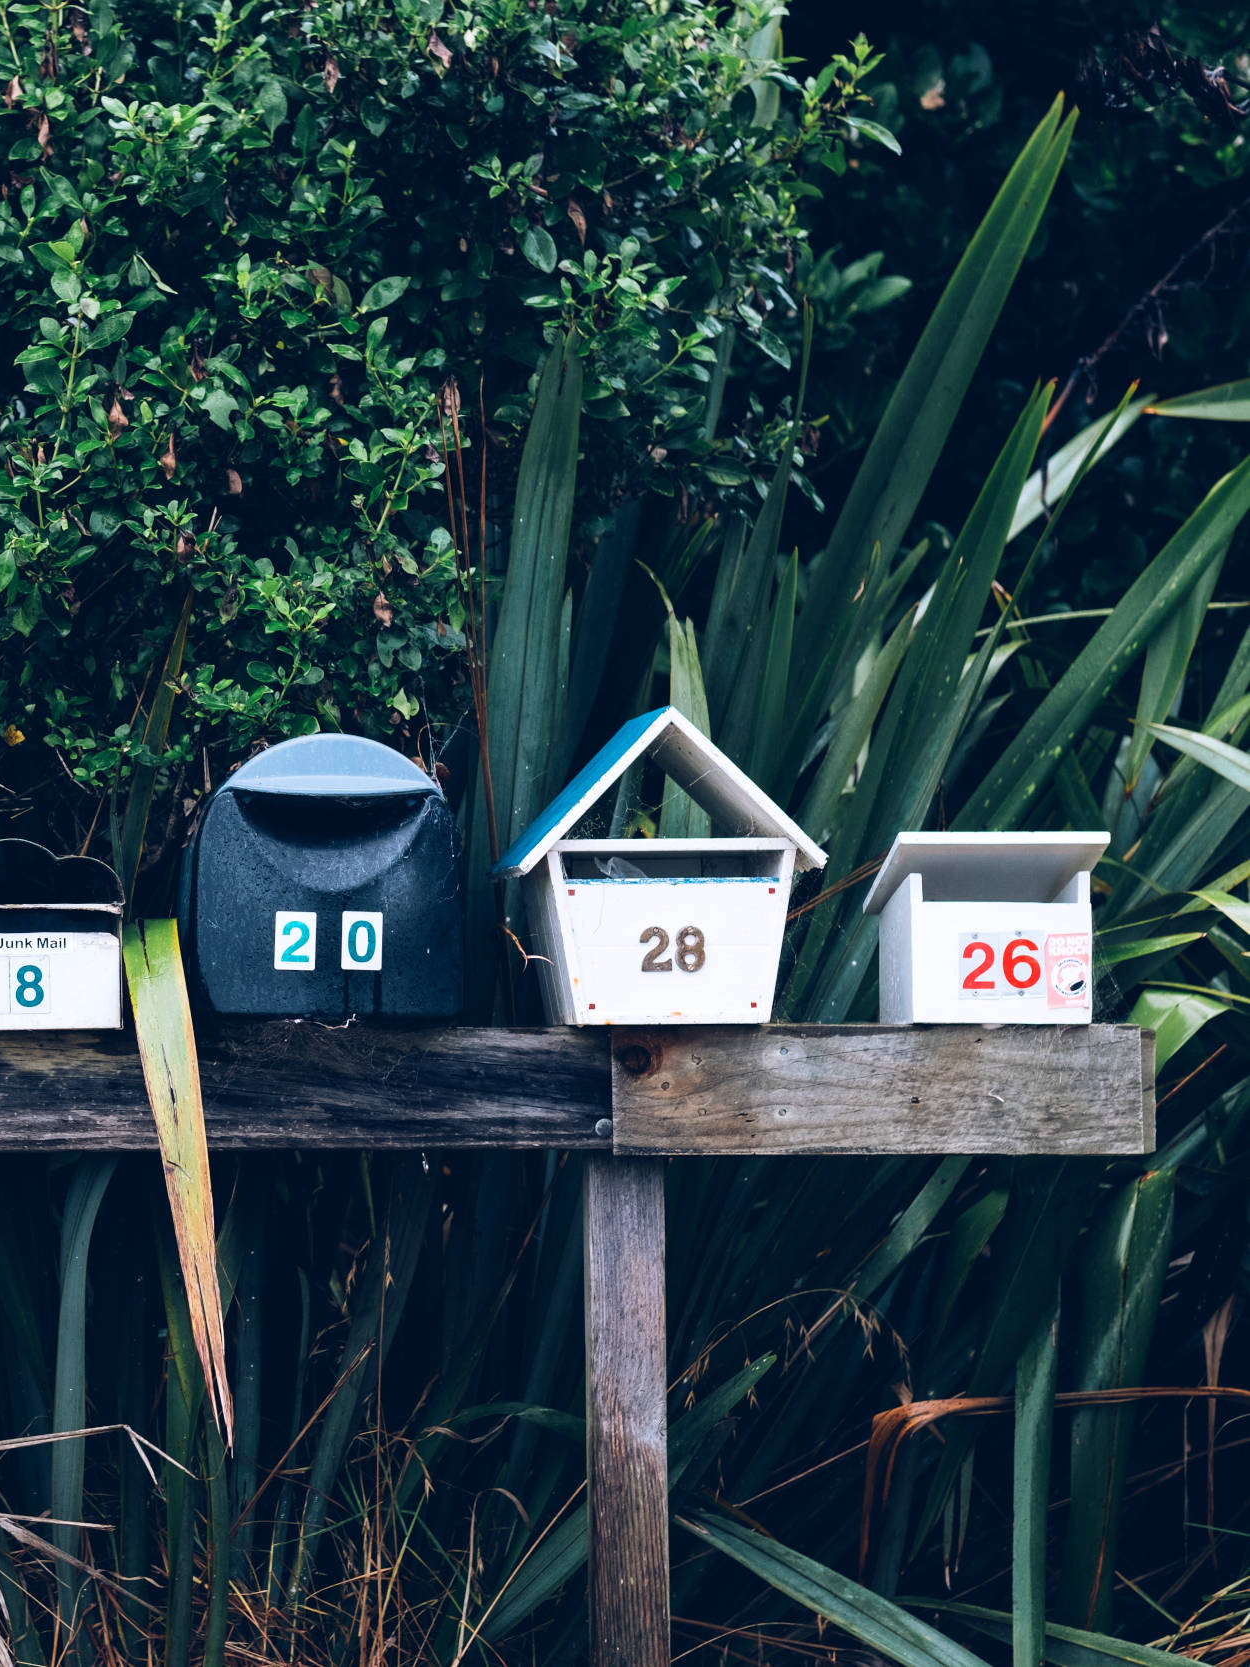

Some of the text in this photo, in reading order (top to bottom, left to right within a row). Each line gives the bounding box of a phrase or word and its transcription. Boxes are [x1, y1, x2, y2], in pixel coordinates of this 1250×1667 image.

[37, 937, 67, 949] Mail
[639, 925, 706, 973] 28
[962, 938, 1042, 990] 26
